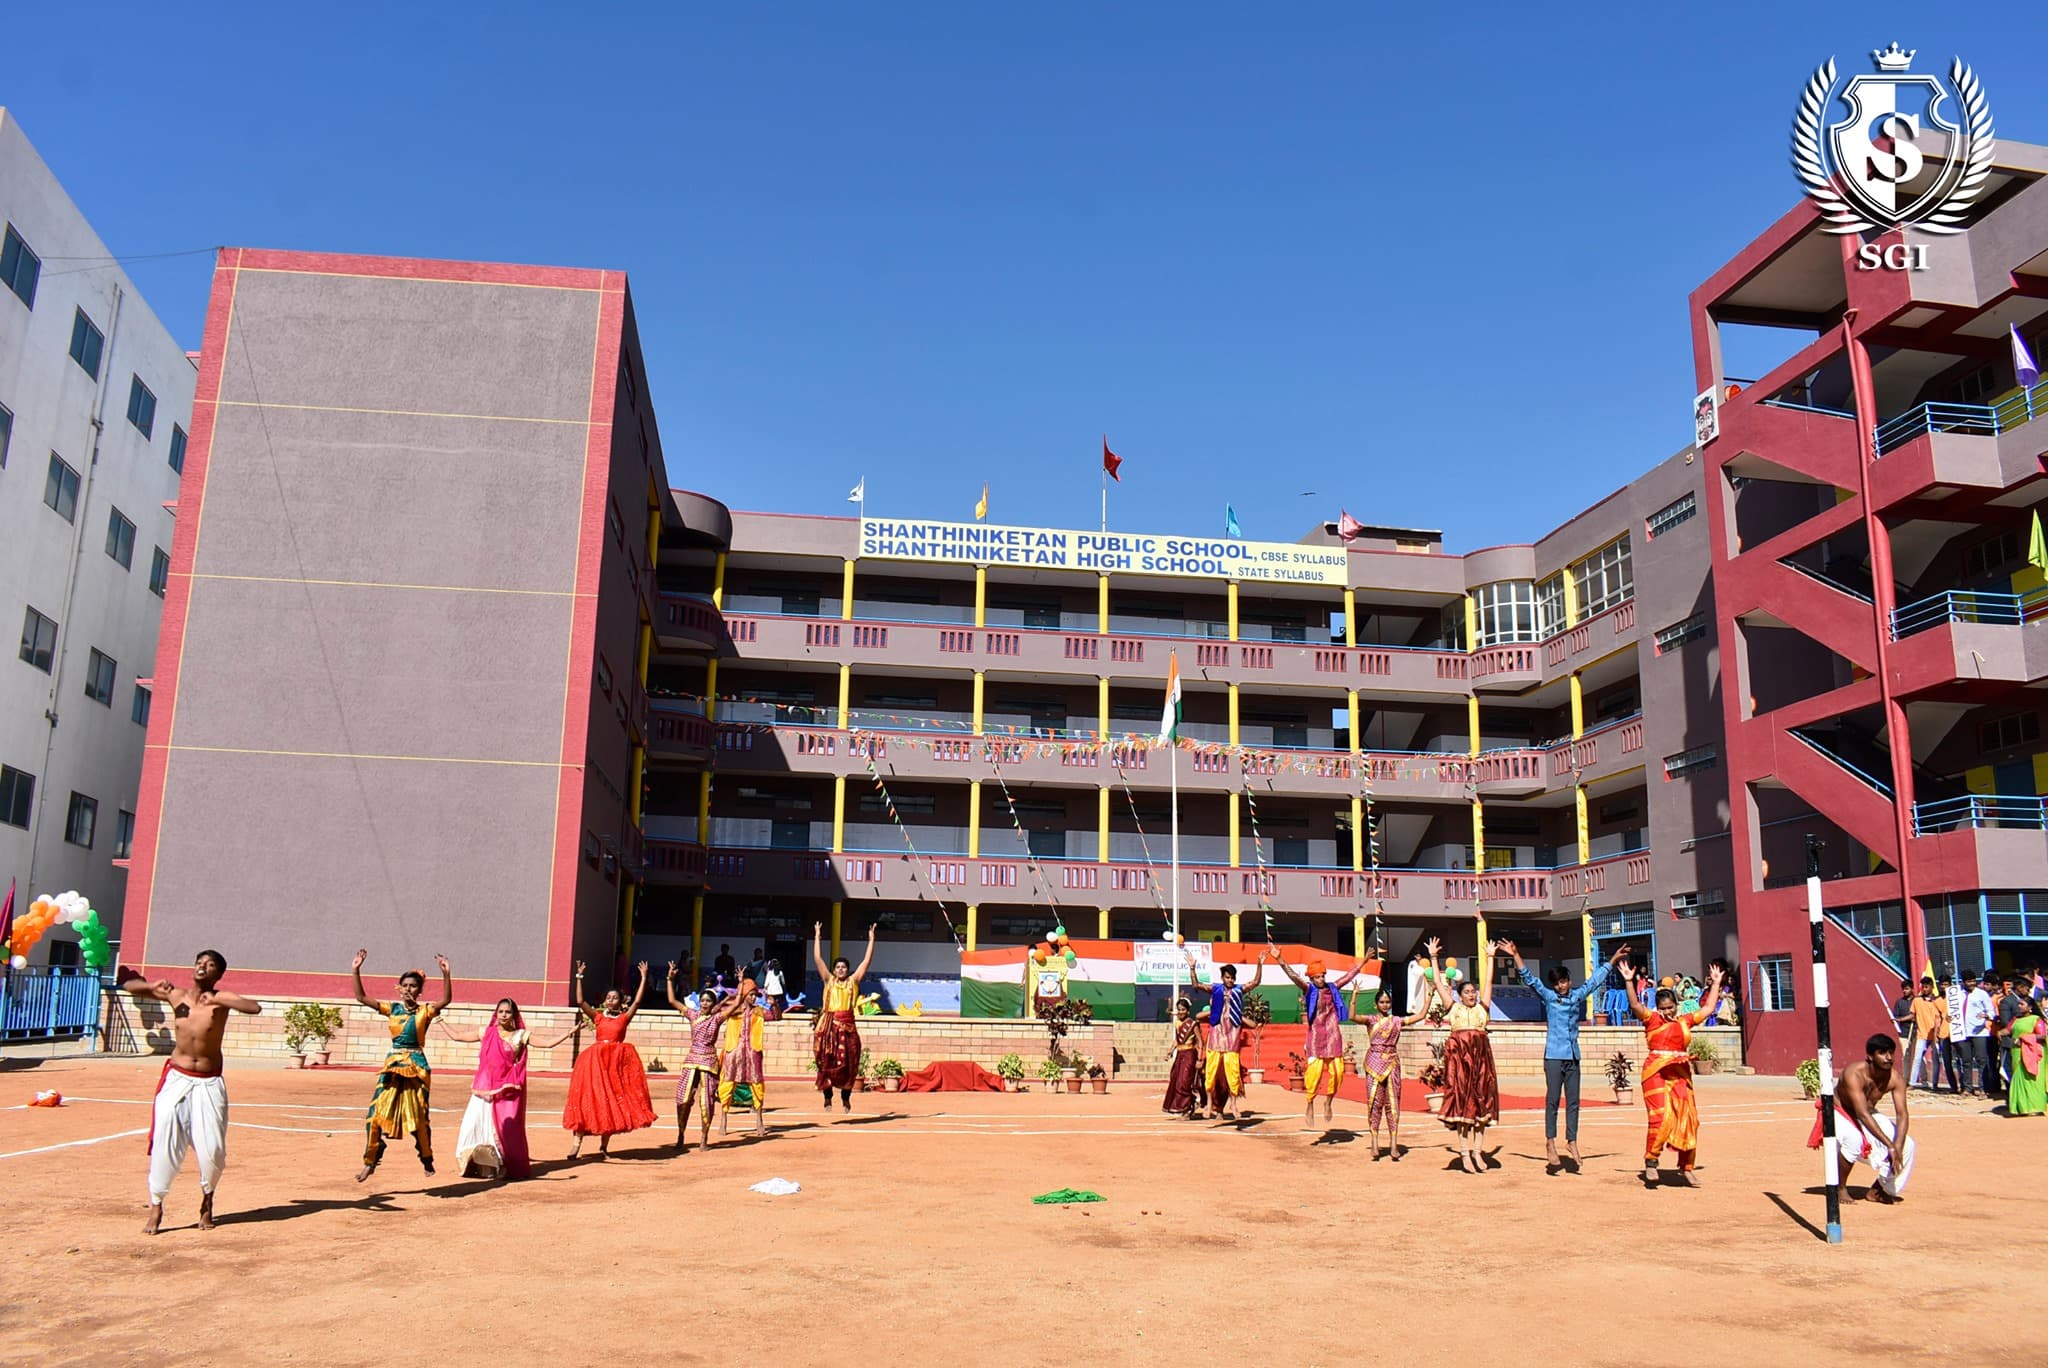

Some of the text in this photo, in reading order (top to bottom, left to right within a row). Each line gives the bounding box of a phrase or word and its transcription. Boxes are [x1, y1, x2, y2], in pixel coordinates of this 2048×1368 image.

[864, 522, 1346, 566] SHANTHINIKETAN PUBLIC SCHOOL, CBSE SYLLABUS
[864, 540, 1324, 581] SHANTHINIKETAN HIGH SCHOOL, STATE SYLLABUS
